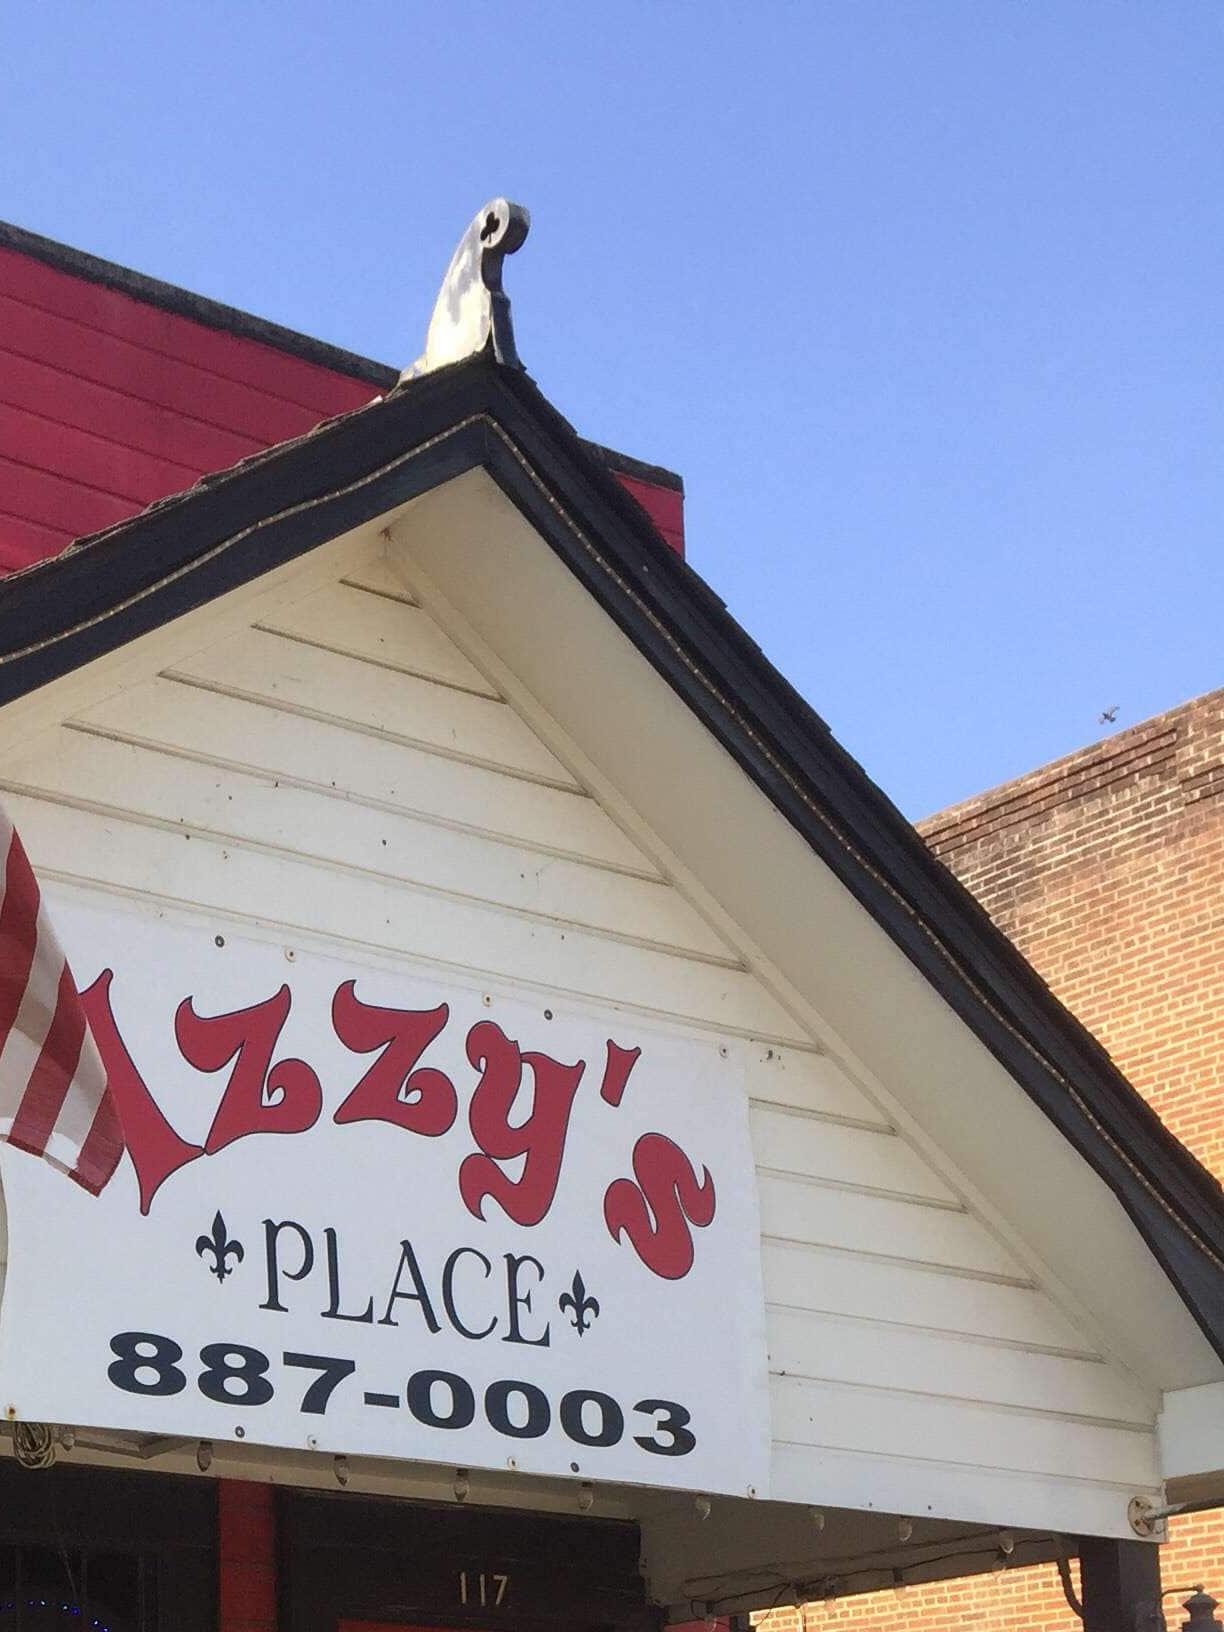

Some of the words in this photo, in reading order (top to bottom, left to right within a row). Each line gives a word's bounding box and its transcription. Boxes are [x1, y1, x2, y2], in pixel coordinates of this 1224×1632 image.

[259, 1217, 551, 1347] PLACE
[106, 1330, 697, 1457] 887-0003
[459, 1571, 508, 1606] 117
